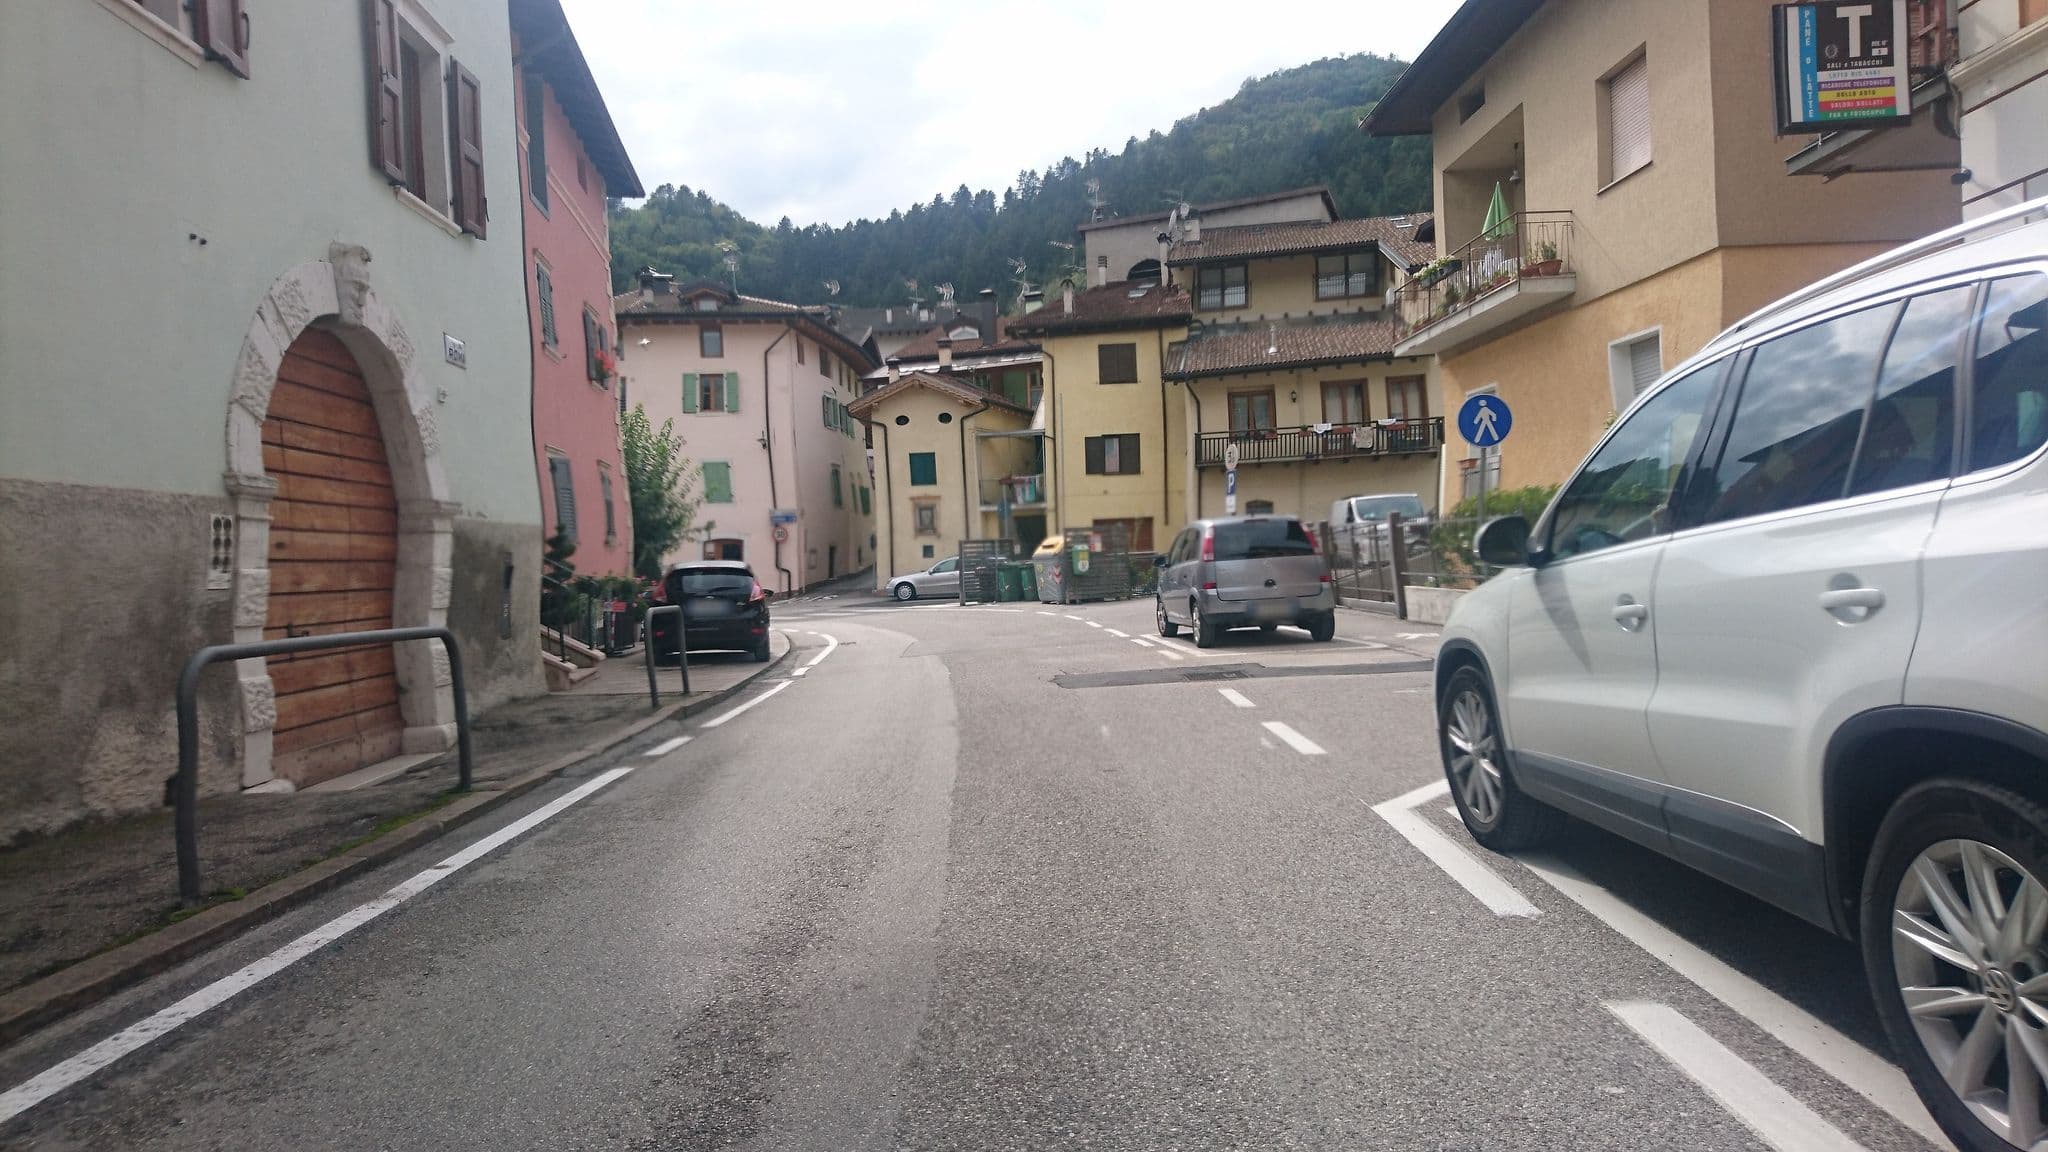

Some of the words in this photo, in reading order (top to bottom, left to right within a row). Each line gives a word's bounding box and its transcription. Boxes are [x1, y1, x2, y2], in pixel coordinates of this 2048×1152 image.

[1836, 4, 1873, 58] T
[1826, 61, 1842, 69] SALI
[1850, 59, 1883, 67] TABACCHI
[1806, 74, 1814, 118] LATTE
[1228, 473, 1235, 493] P
